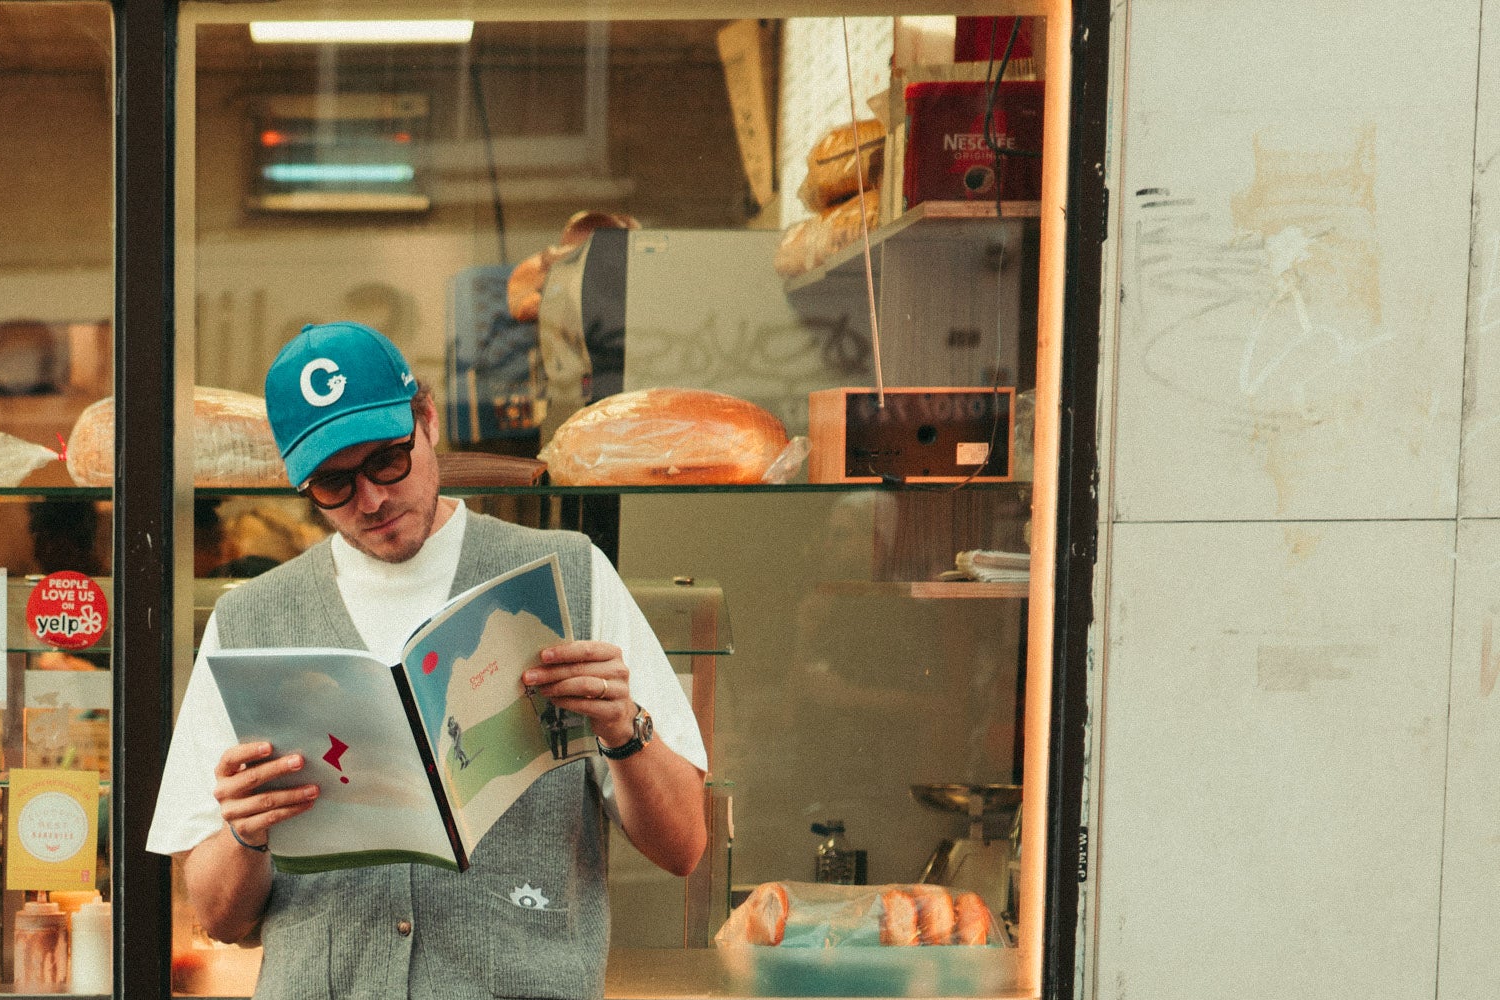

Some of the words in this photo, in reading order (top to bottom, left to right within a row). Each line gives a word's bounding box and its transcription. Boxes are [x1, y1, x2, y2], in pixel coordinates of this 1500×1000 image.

[48, 578, 89, 590] PEOPLE
[41, 588, 75, 602] LOVE
[78, 590, 96, 603] US
[61, 601, 75, 610] ON
[37, 613, 80, 637] yelp
